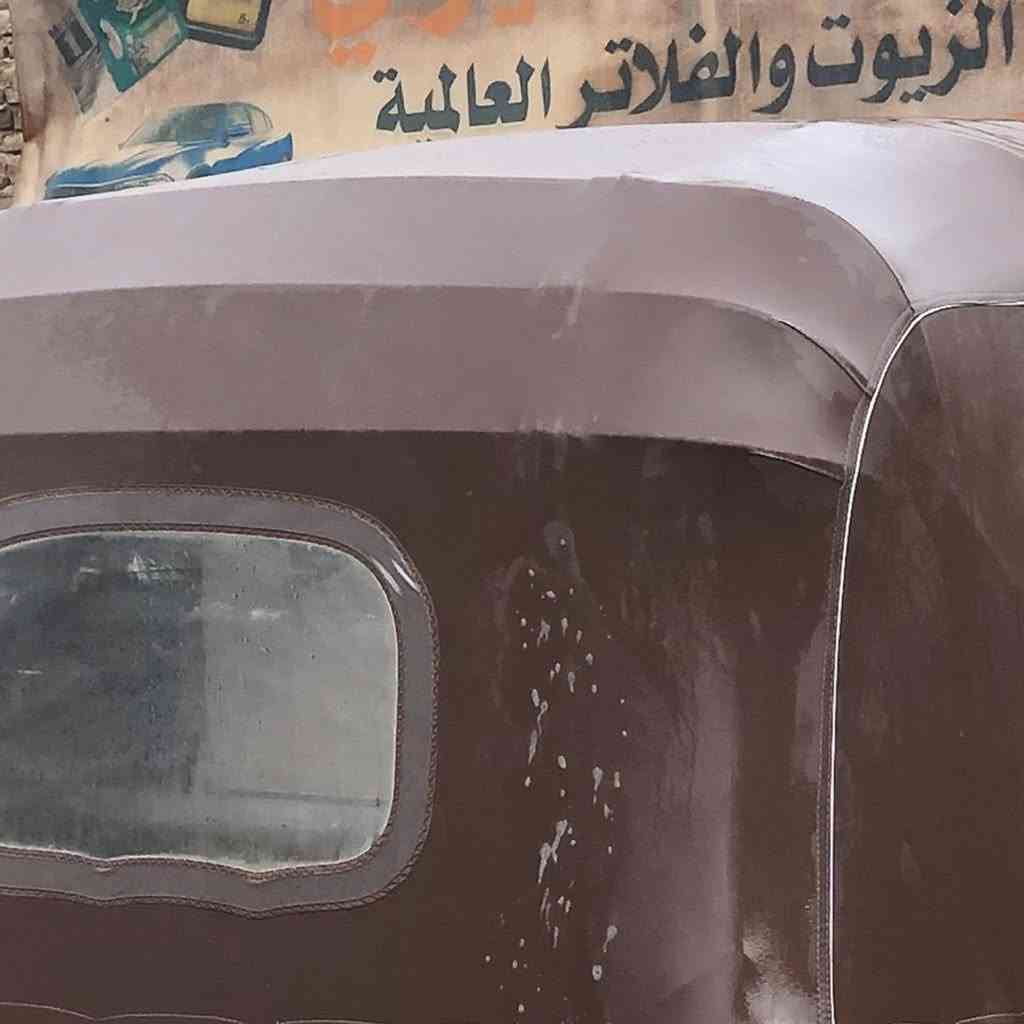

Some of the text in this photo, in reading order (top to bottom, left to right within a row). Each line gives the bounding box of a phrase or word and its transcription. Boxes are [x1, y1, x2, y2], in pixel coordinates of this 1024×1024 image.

[372, 55, 552, 142] العالمية
[555, 22, 797, 129] والفلاتر
[806, 0, 1014, 104] الزيوت
